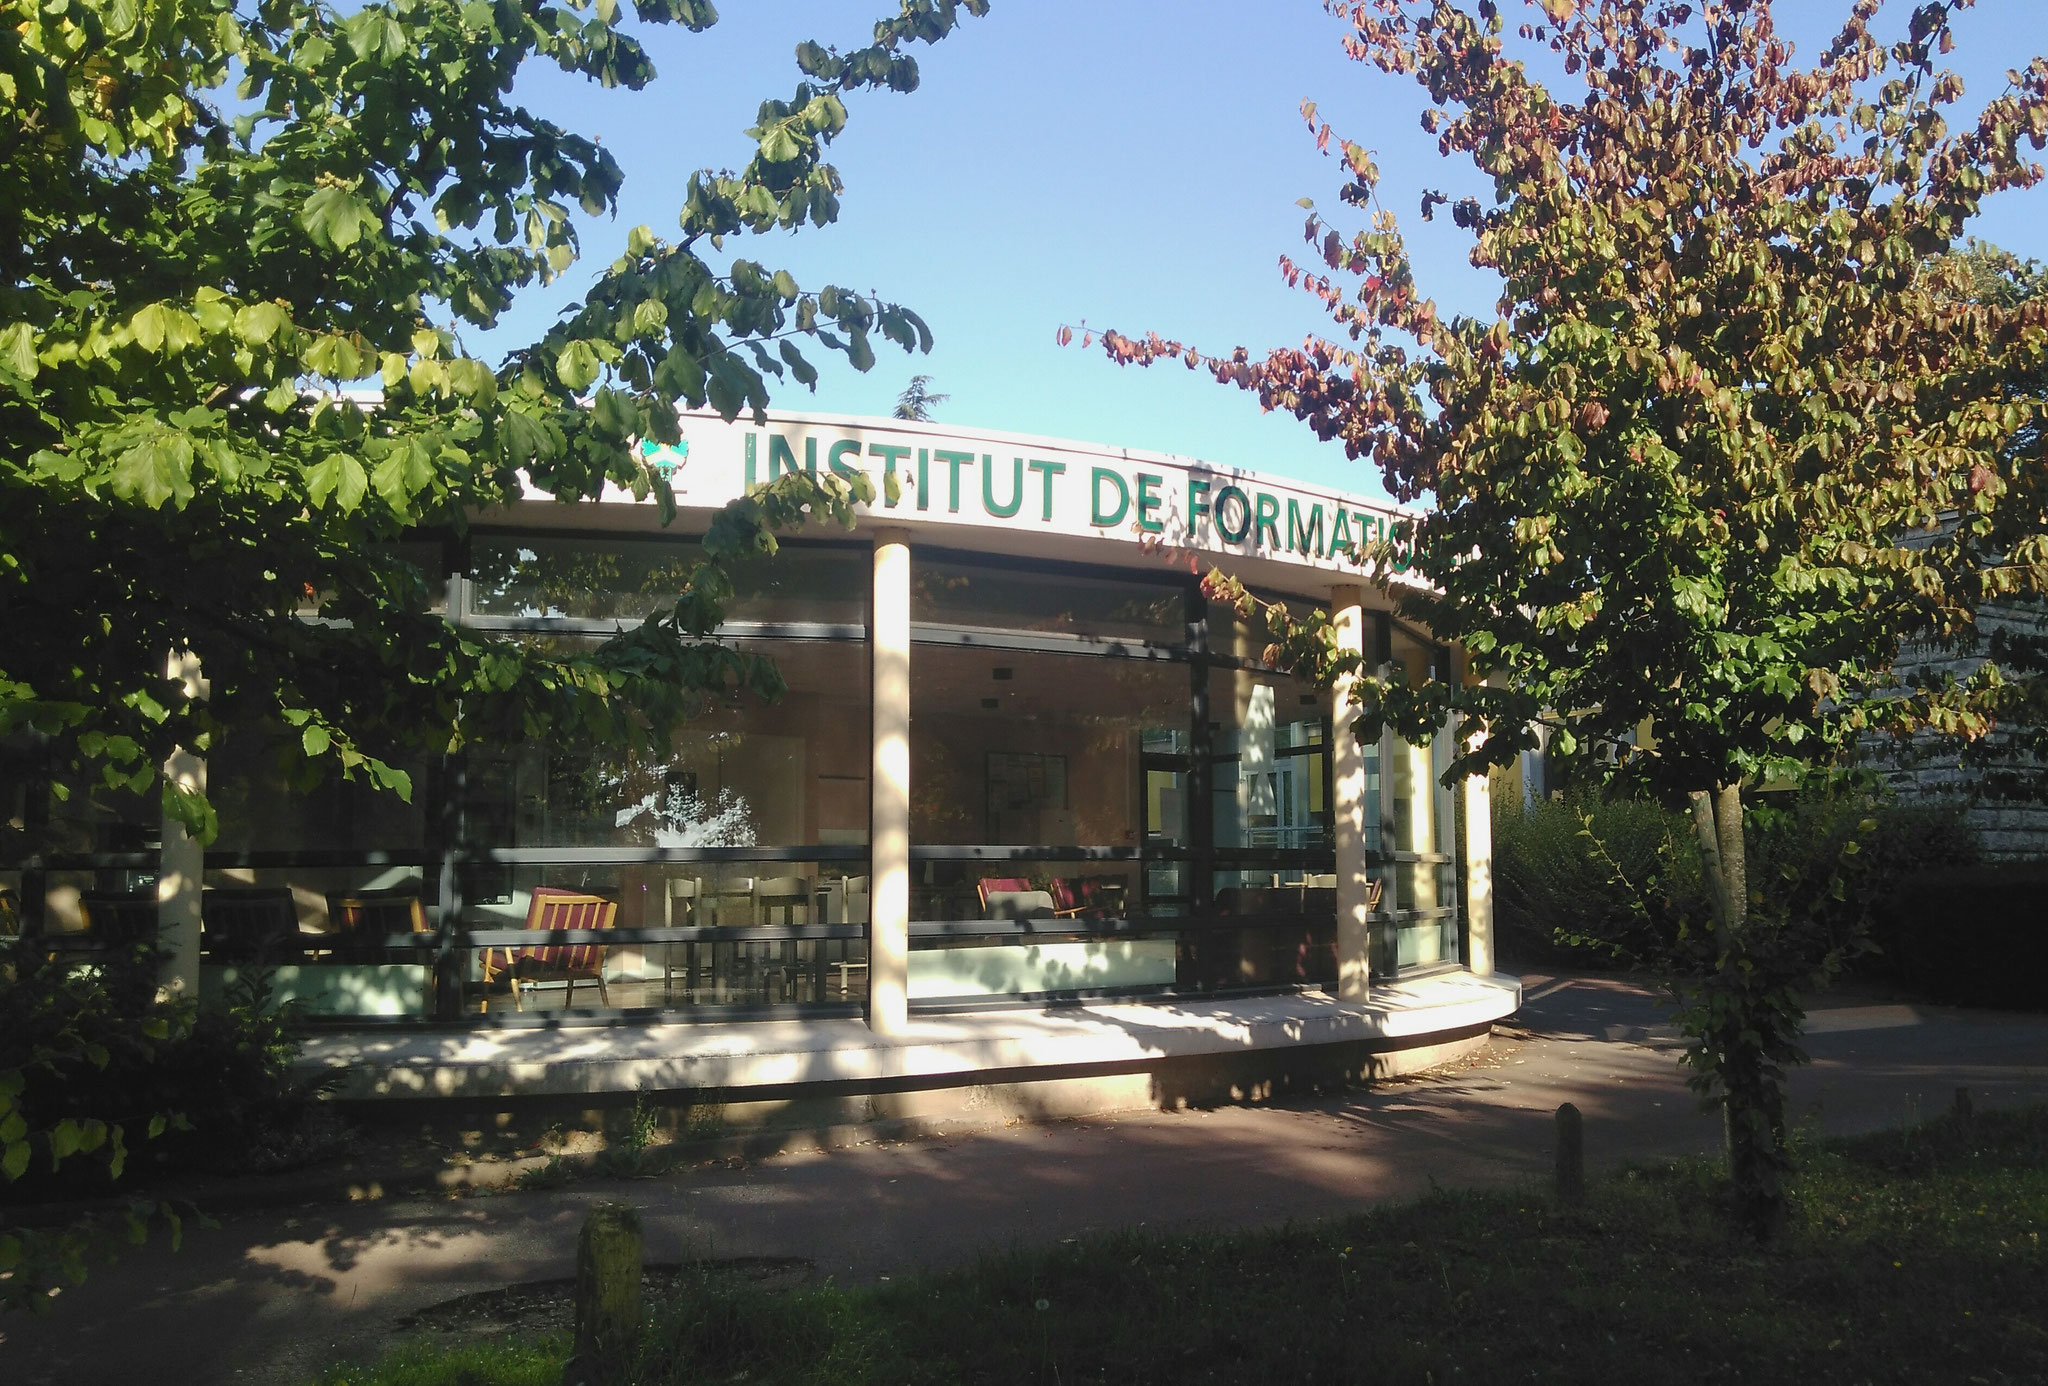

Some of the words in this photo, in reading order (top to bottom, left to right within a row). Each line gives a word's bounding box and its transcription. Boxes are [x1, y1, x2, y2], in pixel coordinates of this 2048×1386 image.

[745, 432, 1066, 521] INSTITUT
[1090, 466, 1164, 534] DE
[1187, 478, 1435, 578] FORMATIO
